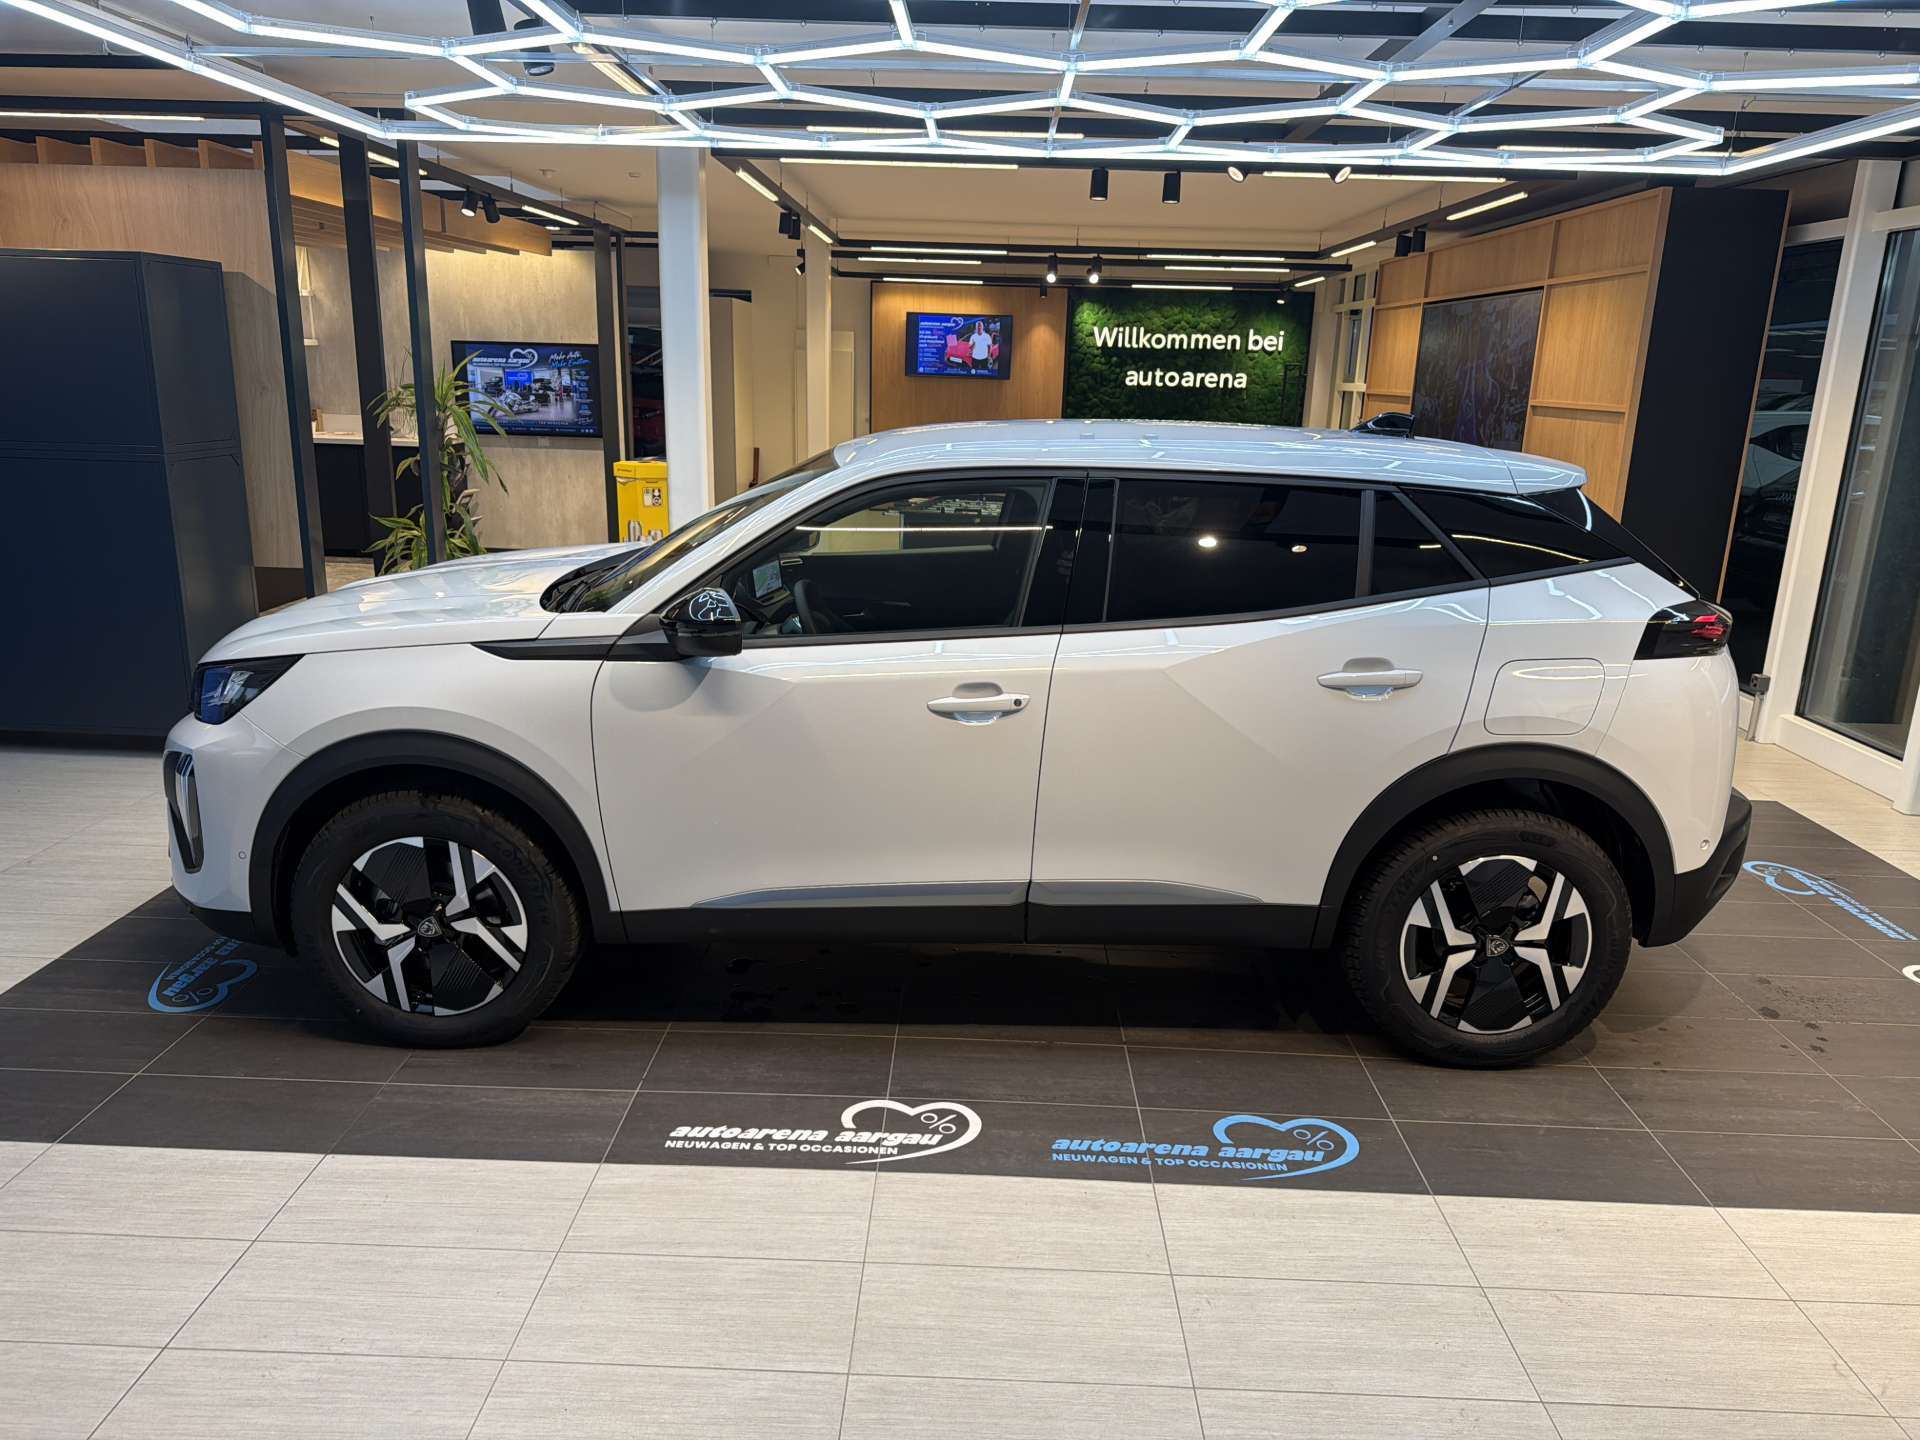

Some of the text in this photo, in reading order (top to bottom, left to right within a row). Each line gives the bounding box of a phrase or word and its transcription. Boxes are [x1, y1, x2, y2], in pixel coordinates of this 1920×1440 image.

[1092, 326, 1285, 352] Willkommen bei
[1124, 368, 1248, 389] autoarena
[669, 1125, 944, 1147] autoarena aargau
[664, 1140, 899, 1156] NEUWAGEN & TOP OCCASIONEN
[1051, 1138, 1325, 1162] autoarena aargau
[1052, 1152, 1139, 1165] NEUWAGEN
[1154, 1157, 1186, 1167] TOP
[1187, 1158, 1289, 1172] OCCASIONEN
